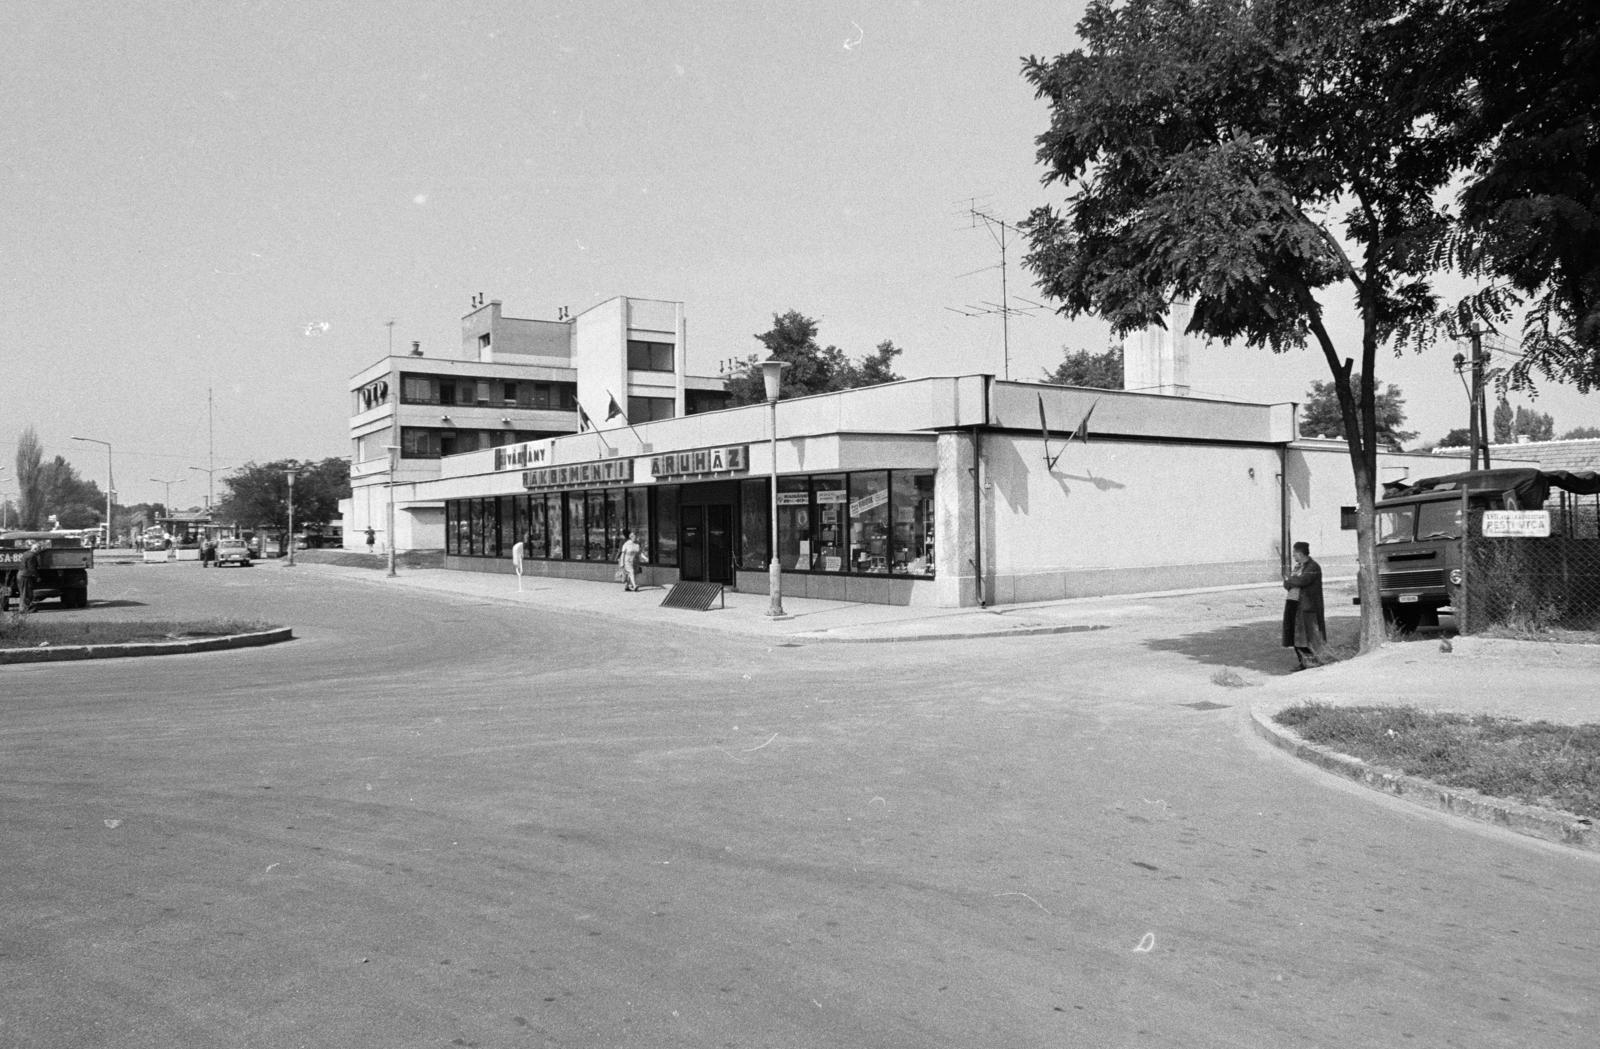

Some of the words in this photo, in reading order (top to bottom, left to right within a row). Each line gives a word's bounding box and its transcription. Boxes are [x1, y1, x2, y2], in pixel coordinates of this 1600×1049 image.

[361, 380, 388, 407] OTP
[523, 462, 624, 486] RÁKOSMENTI
[651, 449, 739, 474] ÁRUHÁZ
